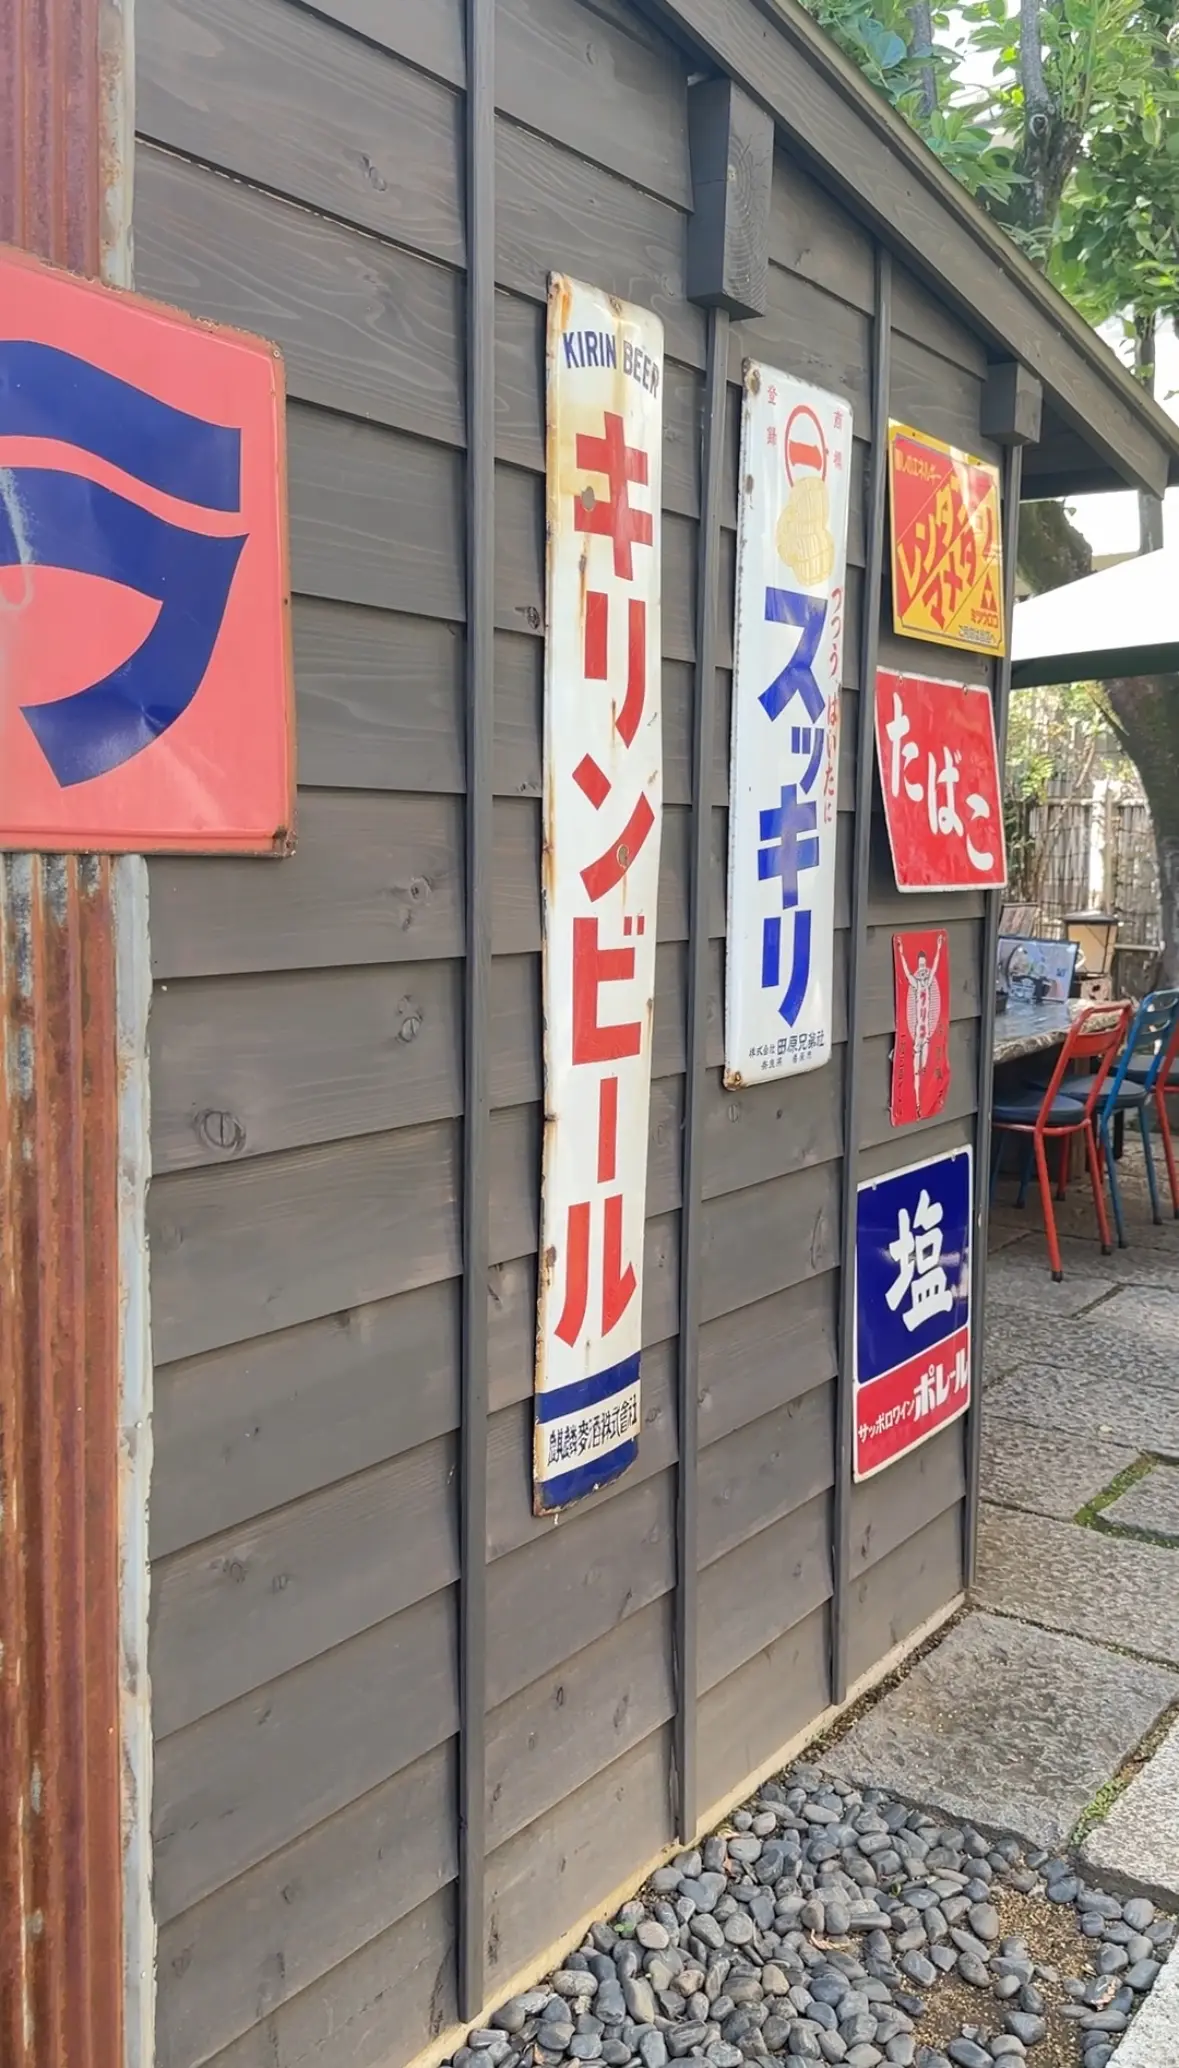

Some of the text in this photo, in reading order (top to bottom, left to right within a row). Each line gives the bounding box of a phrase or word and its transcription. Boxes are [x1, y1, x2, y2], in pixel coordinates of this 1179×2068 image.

[563, 331, 659, 399] KIRIN BEER
[757, 586, 828, 1028] スッキリ
[885, 692, 994, 871] たばこ
[553, 411, 655, 1347] キリンビール
[885, 1189, 953, 1332] 塩
[858, 1349, 969, 1442] サッポロワイン ポレール
